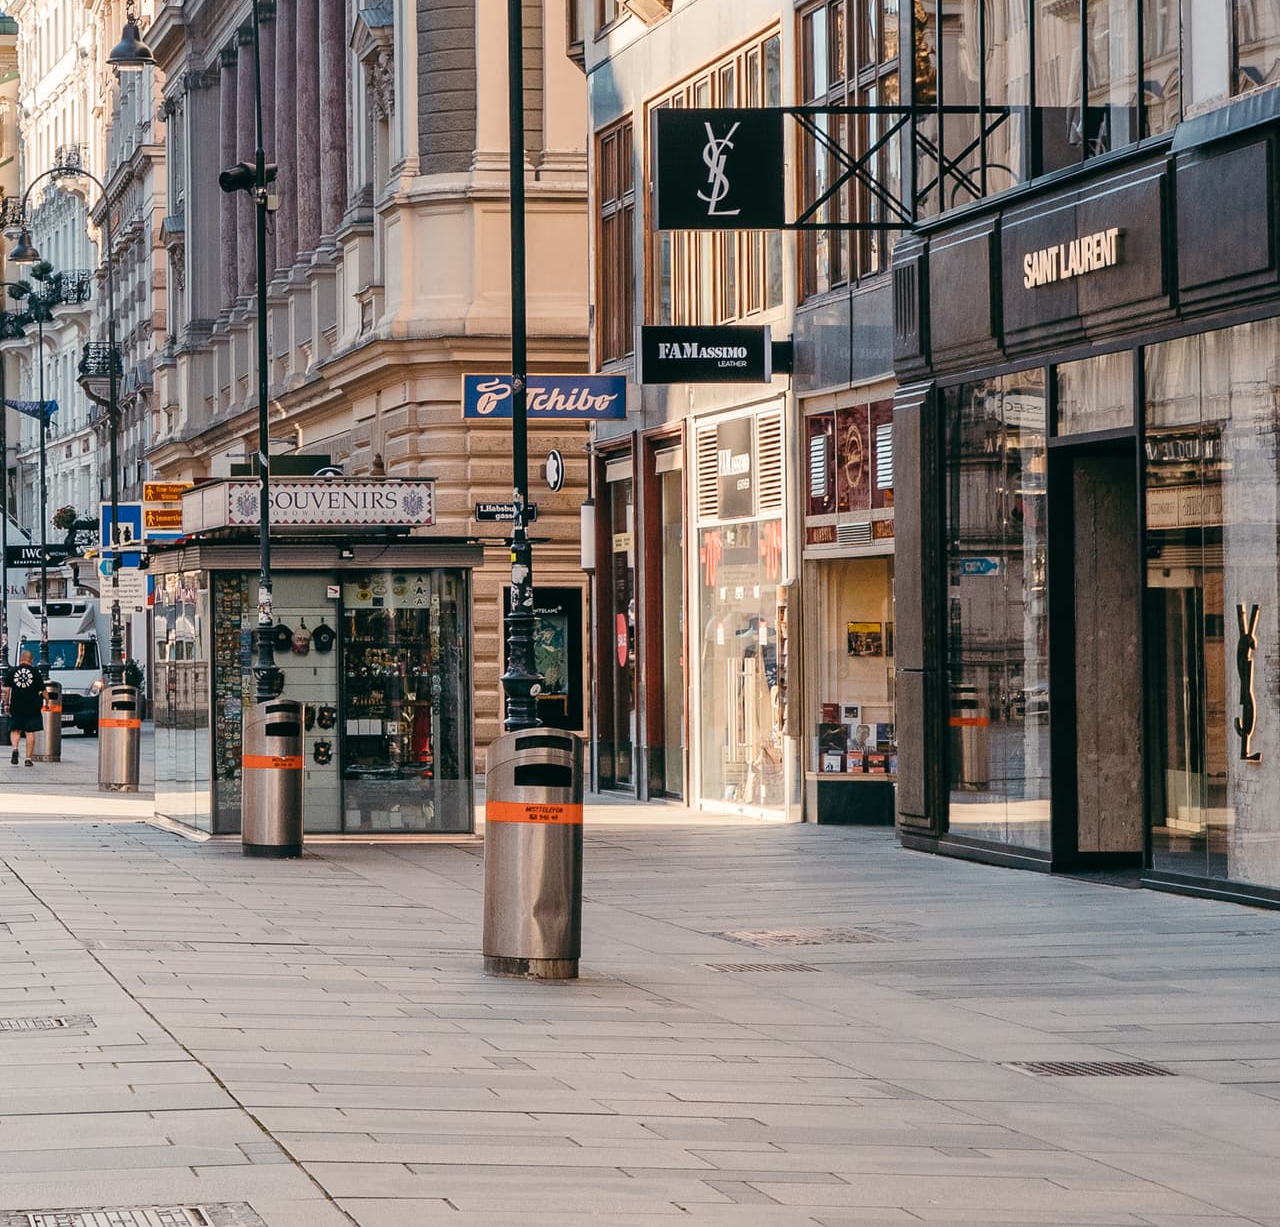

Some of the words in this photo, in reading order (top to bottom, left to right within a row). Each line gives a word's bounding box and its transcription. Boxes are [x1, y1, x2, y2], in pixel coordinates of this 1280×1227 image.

[1024, 245, 1059, 290] SAINT
[1060, 227, 1119, 281] LAURENT
[718, 360, 747, 368] LEATHER
[526, 387, 618, 412] Tchibo
[267, 491, 398, 510] SOUVENIRS
[21, 548, 42, 559] IWC
